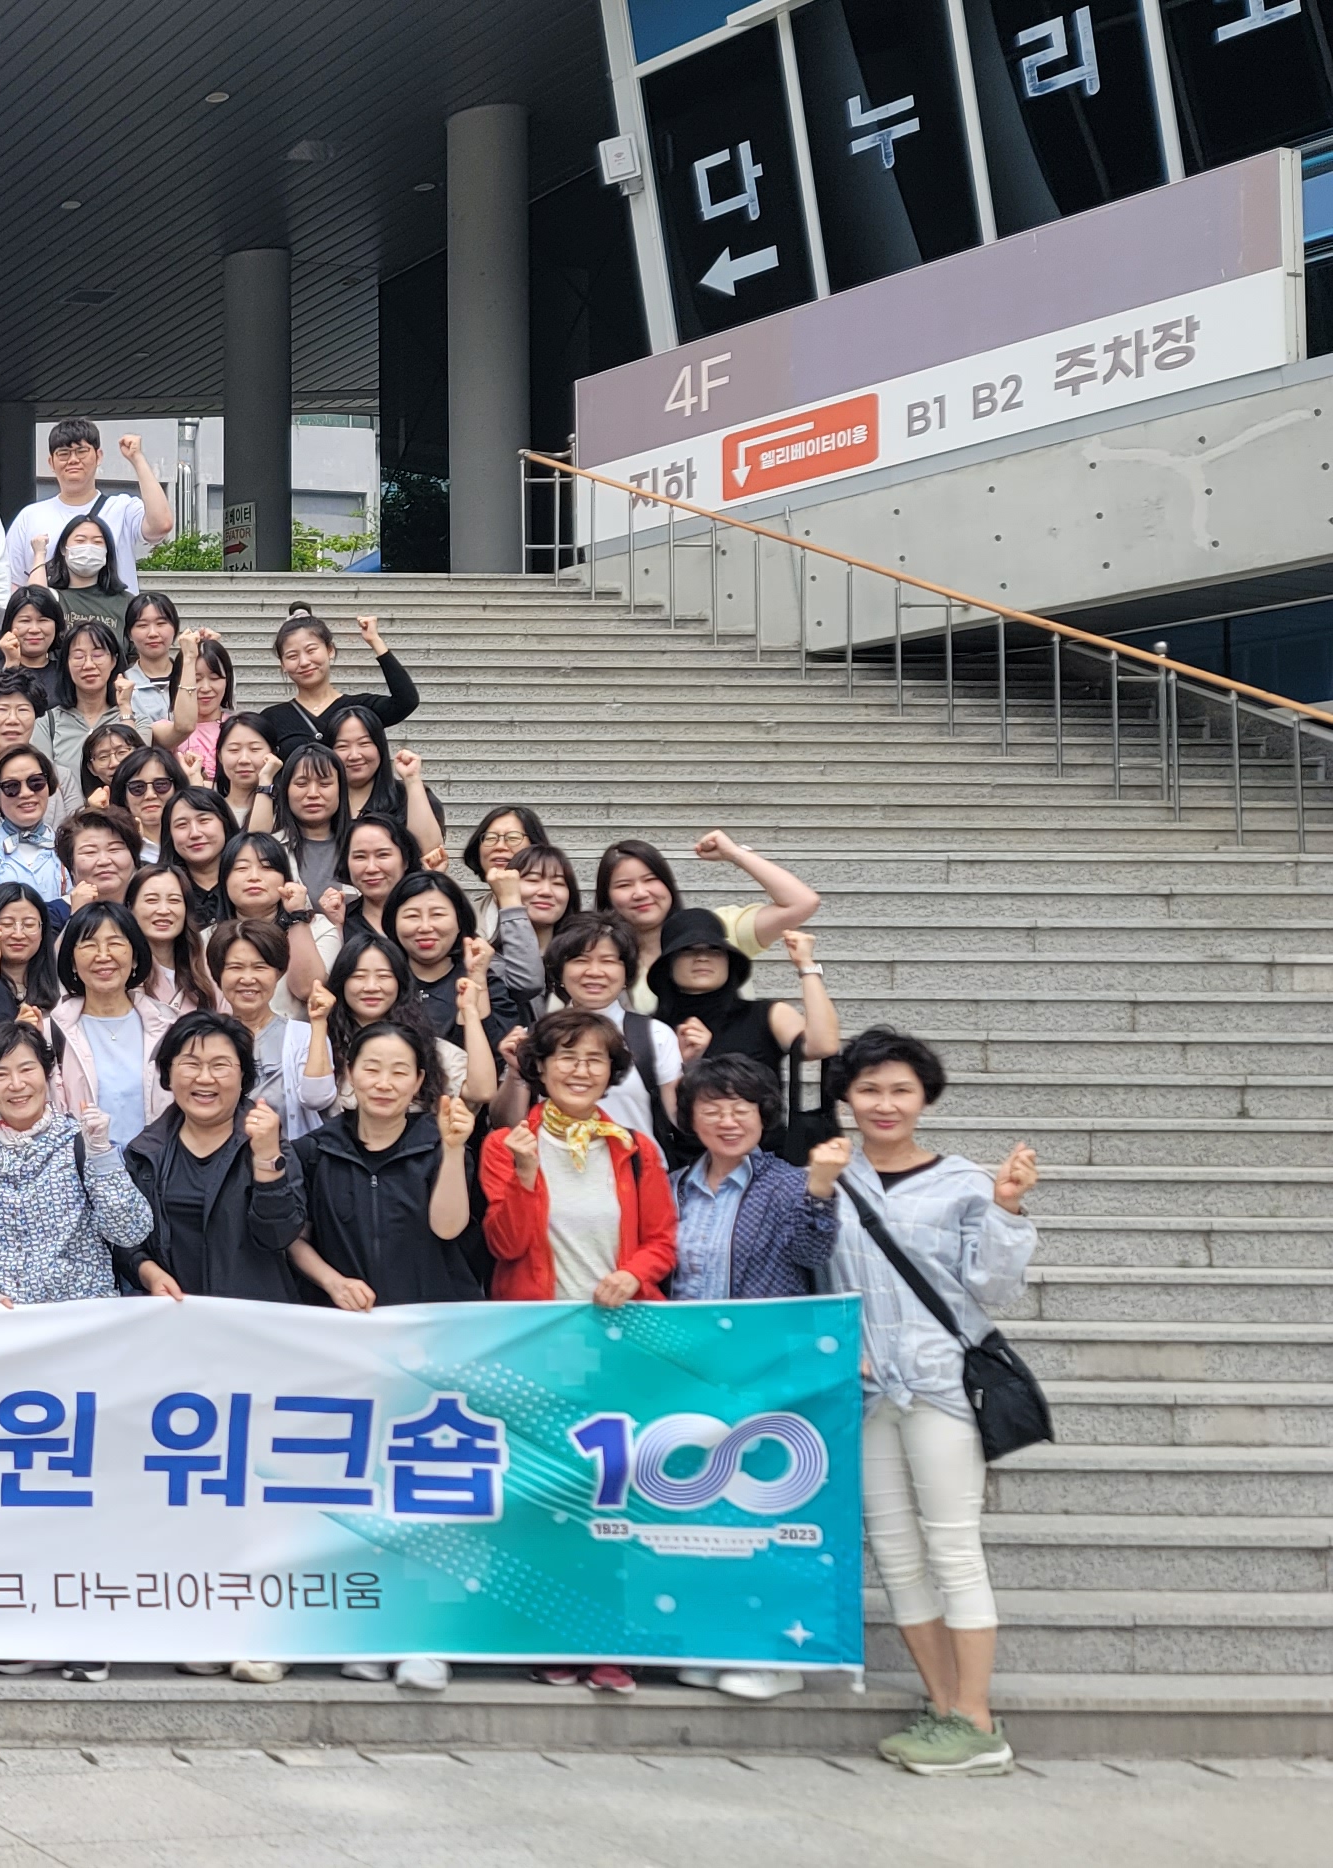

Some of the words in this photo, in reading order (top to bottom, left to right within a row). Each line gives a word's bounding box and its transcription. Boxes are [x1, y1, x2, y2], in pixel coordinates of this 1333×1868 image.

[628, 457, 697, 511] 지하
[906, 394, 947, 438] B1
[971, 374, 1024, 420] B2
[1053, 315, 1201, 397] 주차장
[663, 352, 732, 418] 4F
[143, 1391, 503, 1518] 워크숍
[570, 1412, 829, 1516] 100
[778, 1528, 818, 1542] 2023
[53, 1571, 383, 1611] 다누리아쿠아리움
